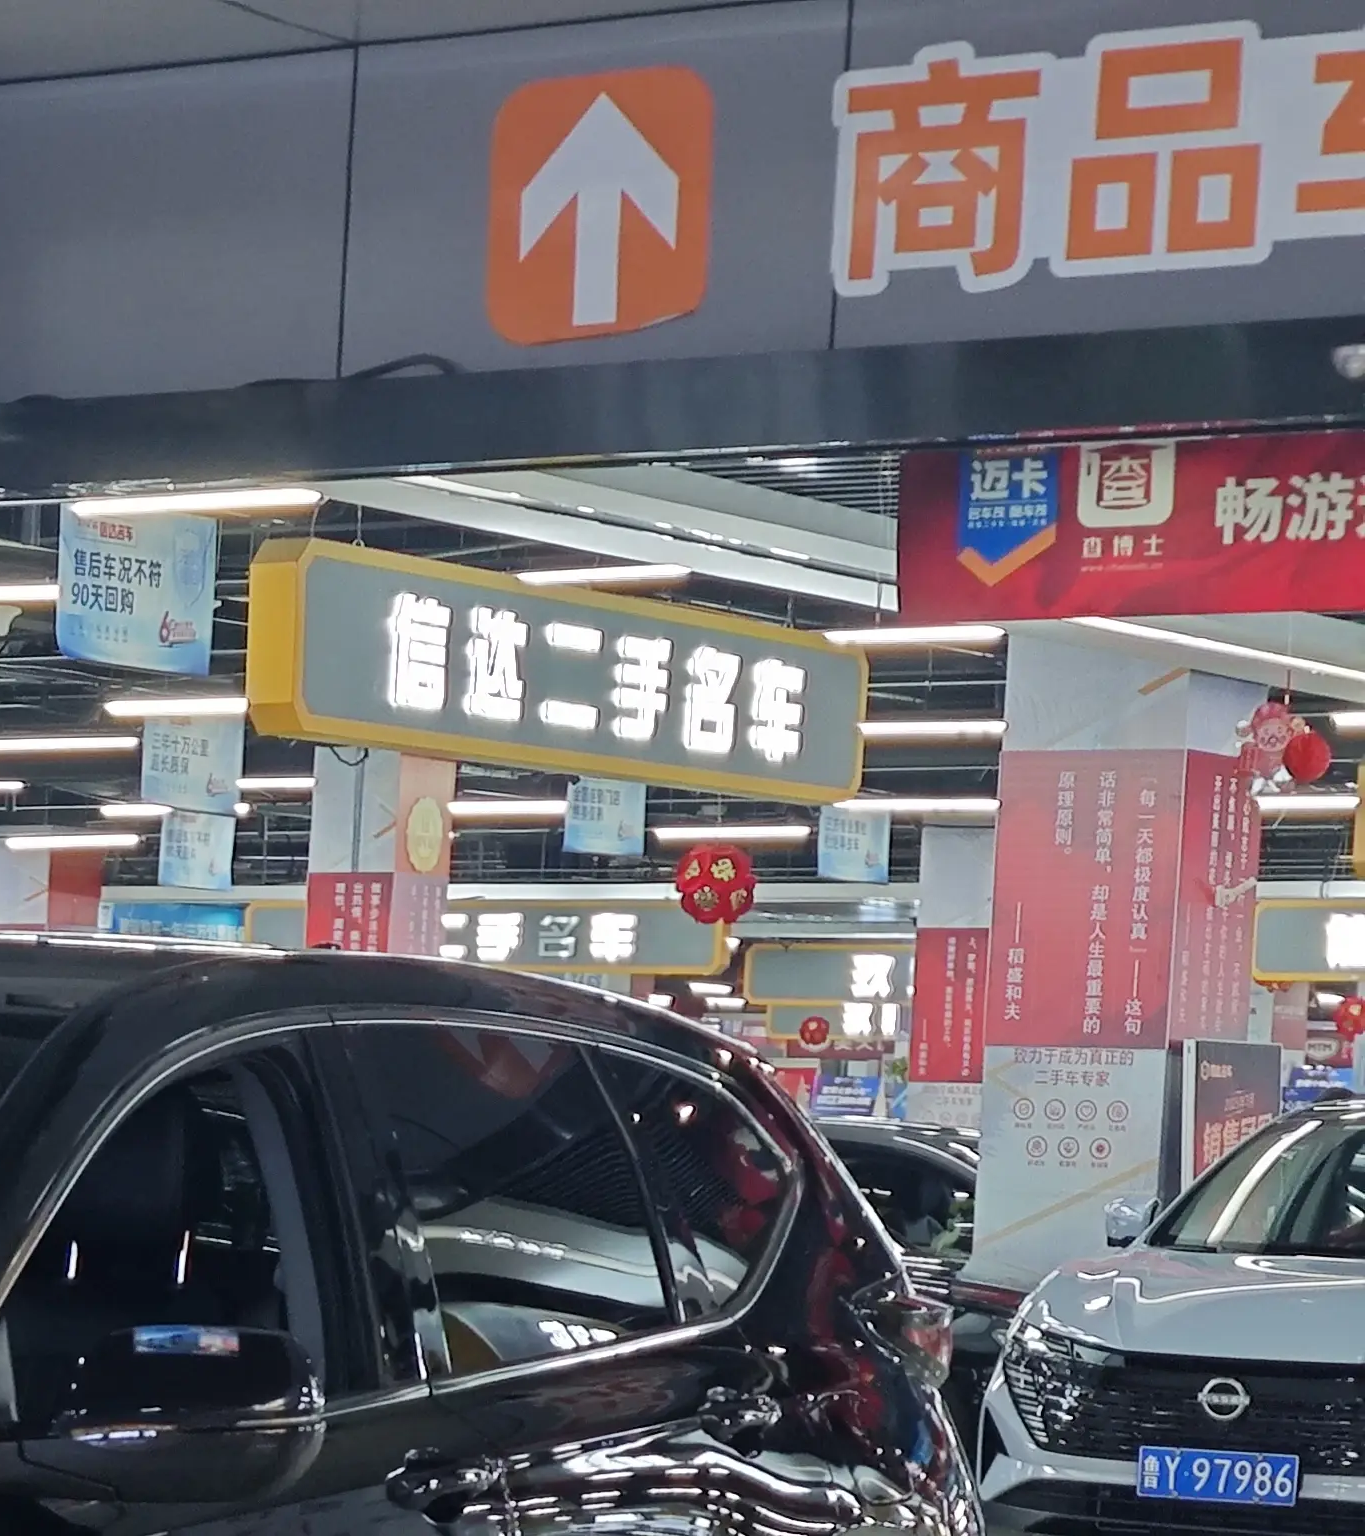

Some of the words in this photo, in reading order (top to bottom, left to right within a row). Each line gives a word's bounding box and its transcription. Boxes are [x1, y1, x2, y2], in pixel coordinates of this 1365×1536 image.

[970, 457, 1049, 500] 迈卡
[1215, 472, 1365, 545] 畅游
[73, 548, 162, 589] 售后车况不符
[71, 582, 135, 615] 90天回购
[388, 592, 807, 762] 信达二手名车
[1014, 1047, 1134, 1066] 致力于成为真正的
[1034, 1069, 1111, 1087] 二手车专家
